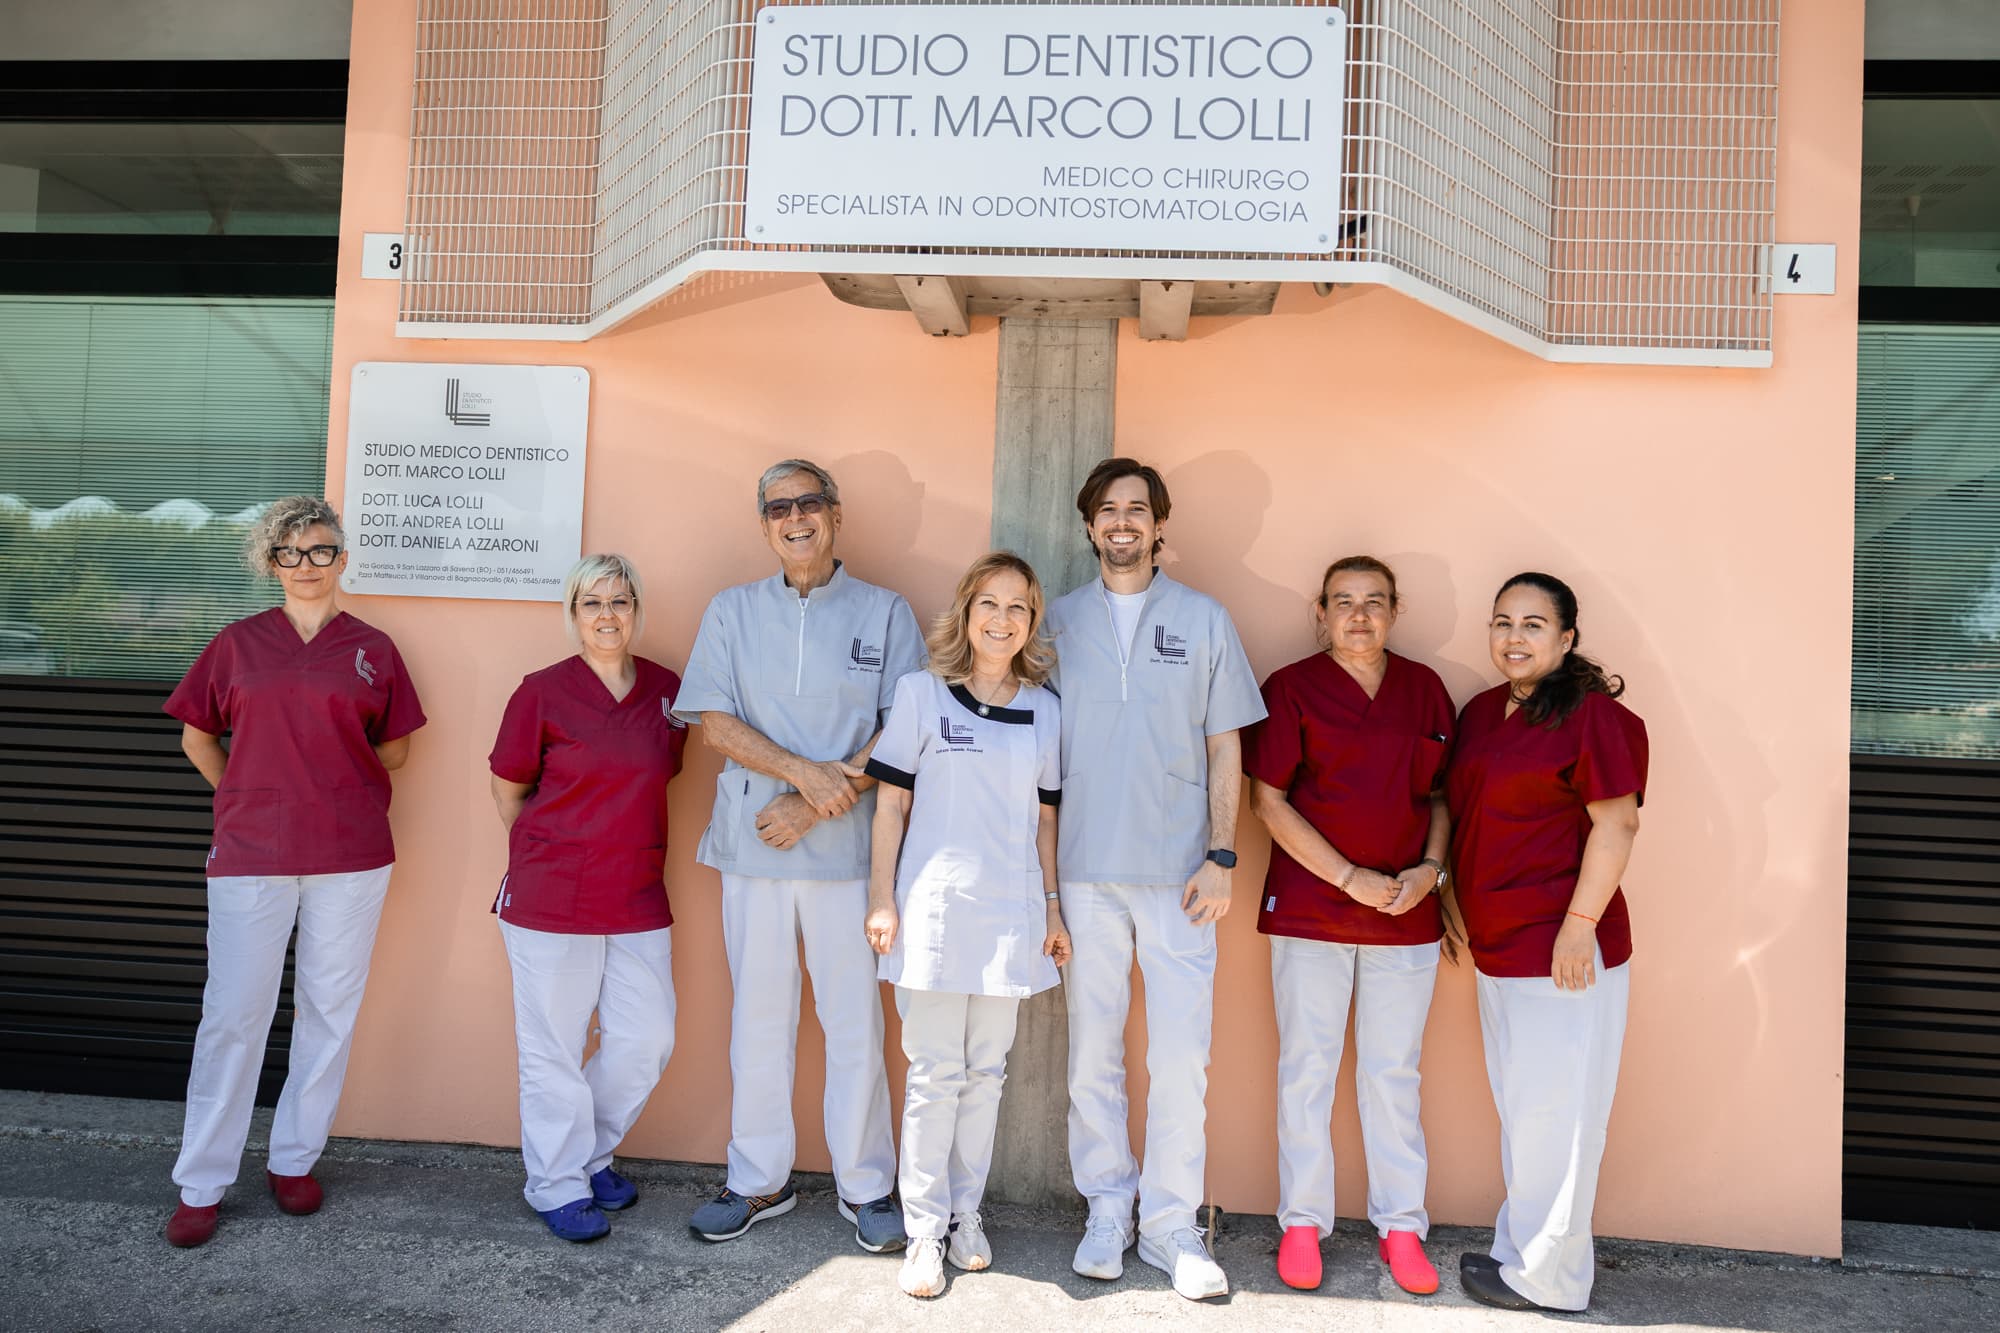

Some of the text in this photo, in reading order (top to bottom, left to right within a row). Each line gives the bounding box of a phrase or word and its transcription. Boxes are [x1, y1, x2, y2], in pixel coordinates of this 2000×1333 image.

[782, 33, 1313, 79] STUDIO DENTISTICO
[779, 94, 1311, 143] DOTT. MARCO LOLLI
[1043, 166, 1310, 192] MEDICO CHIRURGO
[776, 194, 1309, 223] SPECIALISTA IN ODONTOSTOMATOLOGIA
[389, 242, 402, 270] 3
[1787, 253, 1802, 284] 4
[364, 443, 569, 462] STUDIO MEDICO DENTISTICO
[363, 464, 505, 481] DOTT. MARCO LOLLI
[362, 493, 483, 510] DOTT. LUCA LOLLI
[360, 513, 504, 531] DOTT. ANDREA LOLLI
[359, 534, 539, 553] DOTT. DANIELA AZZARONI
[402, 563, 415, 571] San
[441, 564, 449, 572] di
[450, 565, 475, 573] Savena
[476, 566, 492, 574] (BO)
[415, 573, 445, 581] Villanova
[446, 574, 454, 582] di
[454, 575, 502, 584] Bagnacavallo
[503, 576, 518, 585] (RA)
